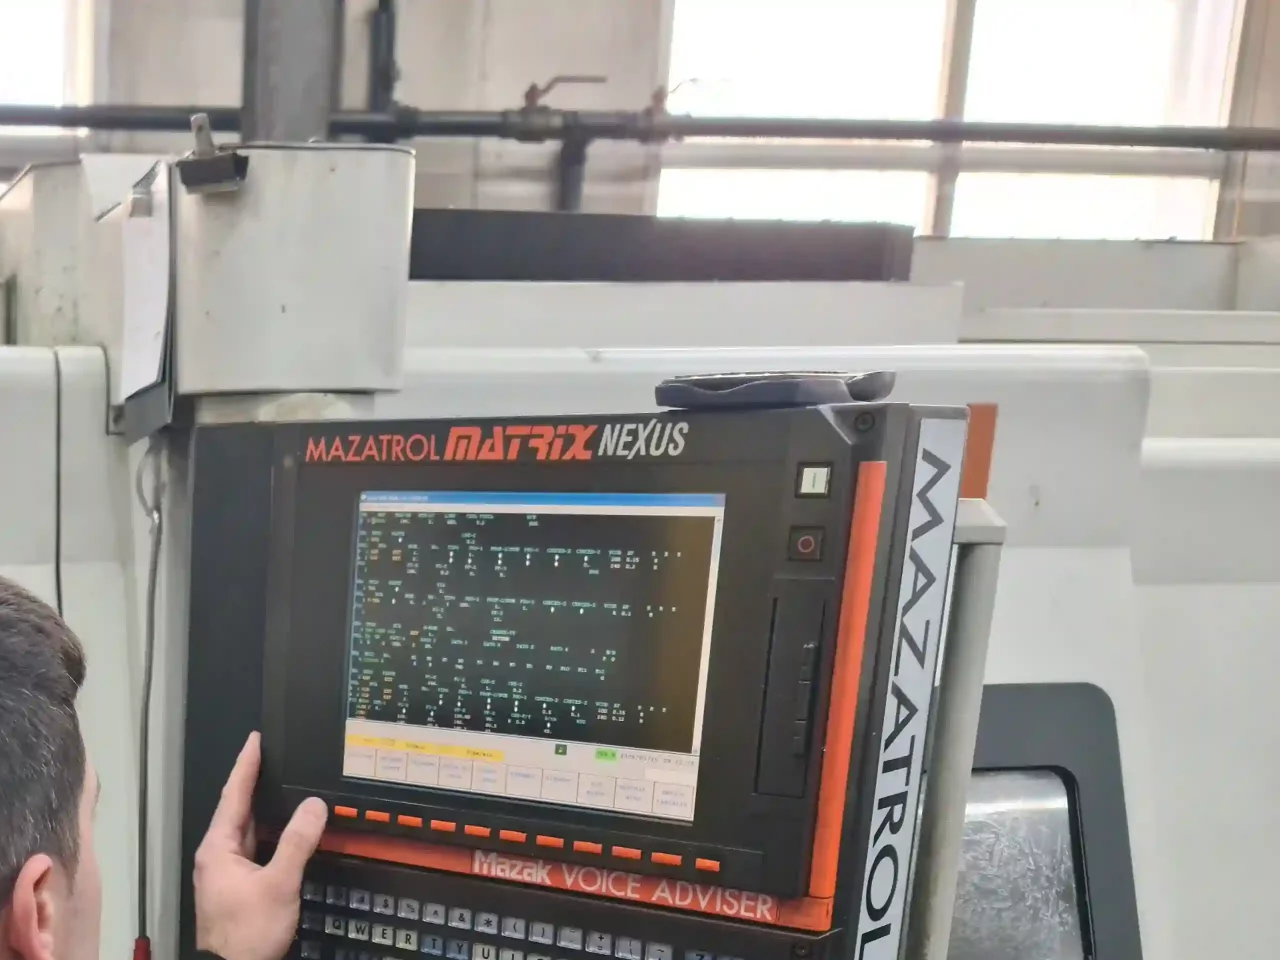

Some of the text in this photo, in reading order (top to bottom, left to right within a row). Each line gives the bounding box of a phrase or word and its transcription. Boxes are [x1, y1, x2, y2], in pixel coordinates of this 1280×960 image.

[305, 418, 689, 463] MAZATROL MATRIX NEXUS
[473, 848, 773, 921] Mazak VOICE ADVISER
[332, 920, 342, 931] Q
[355, 924, 366, 935] W
[381, 928, 388, 939] E
[405, 933, 412, 945] R
[431, 937, 438, 949] T
[456, 942, 464, 954] Y
[482, 947, 490, 959] U
